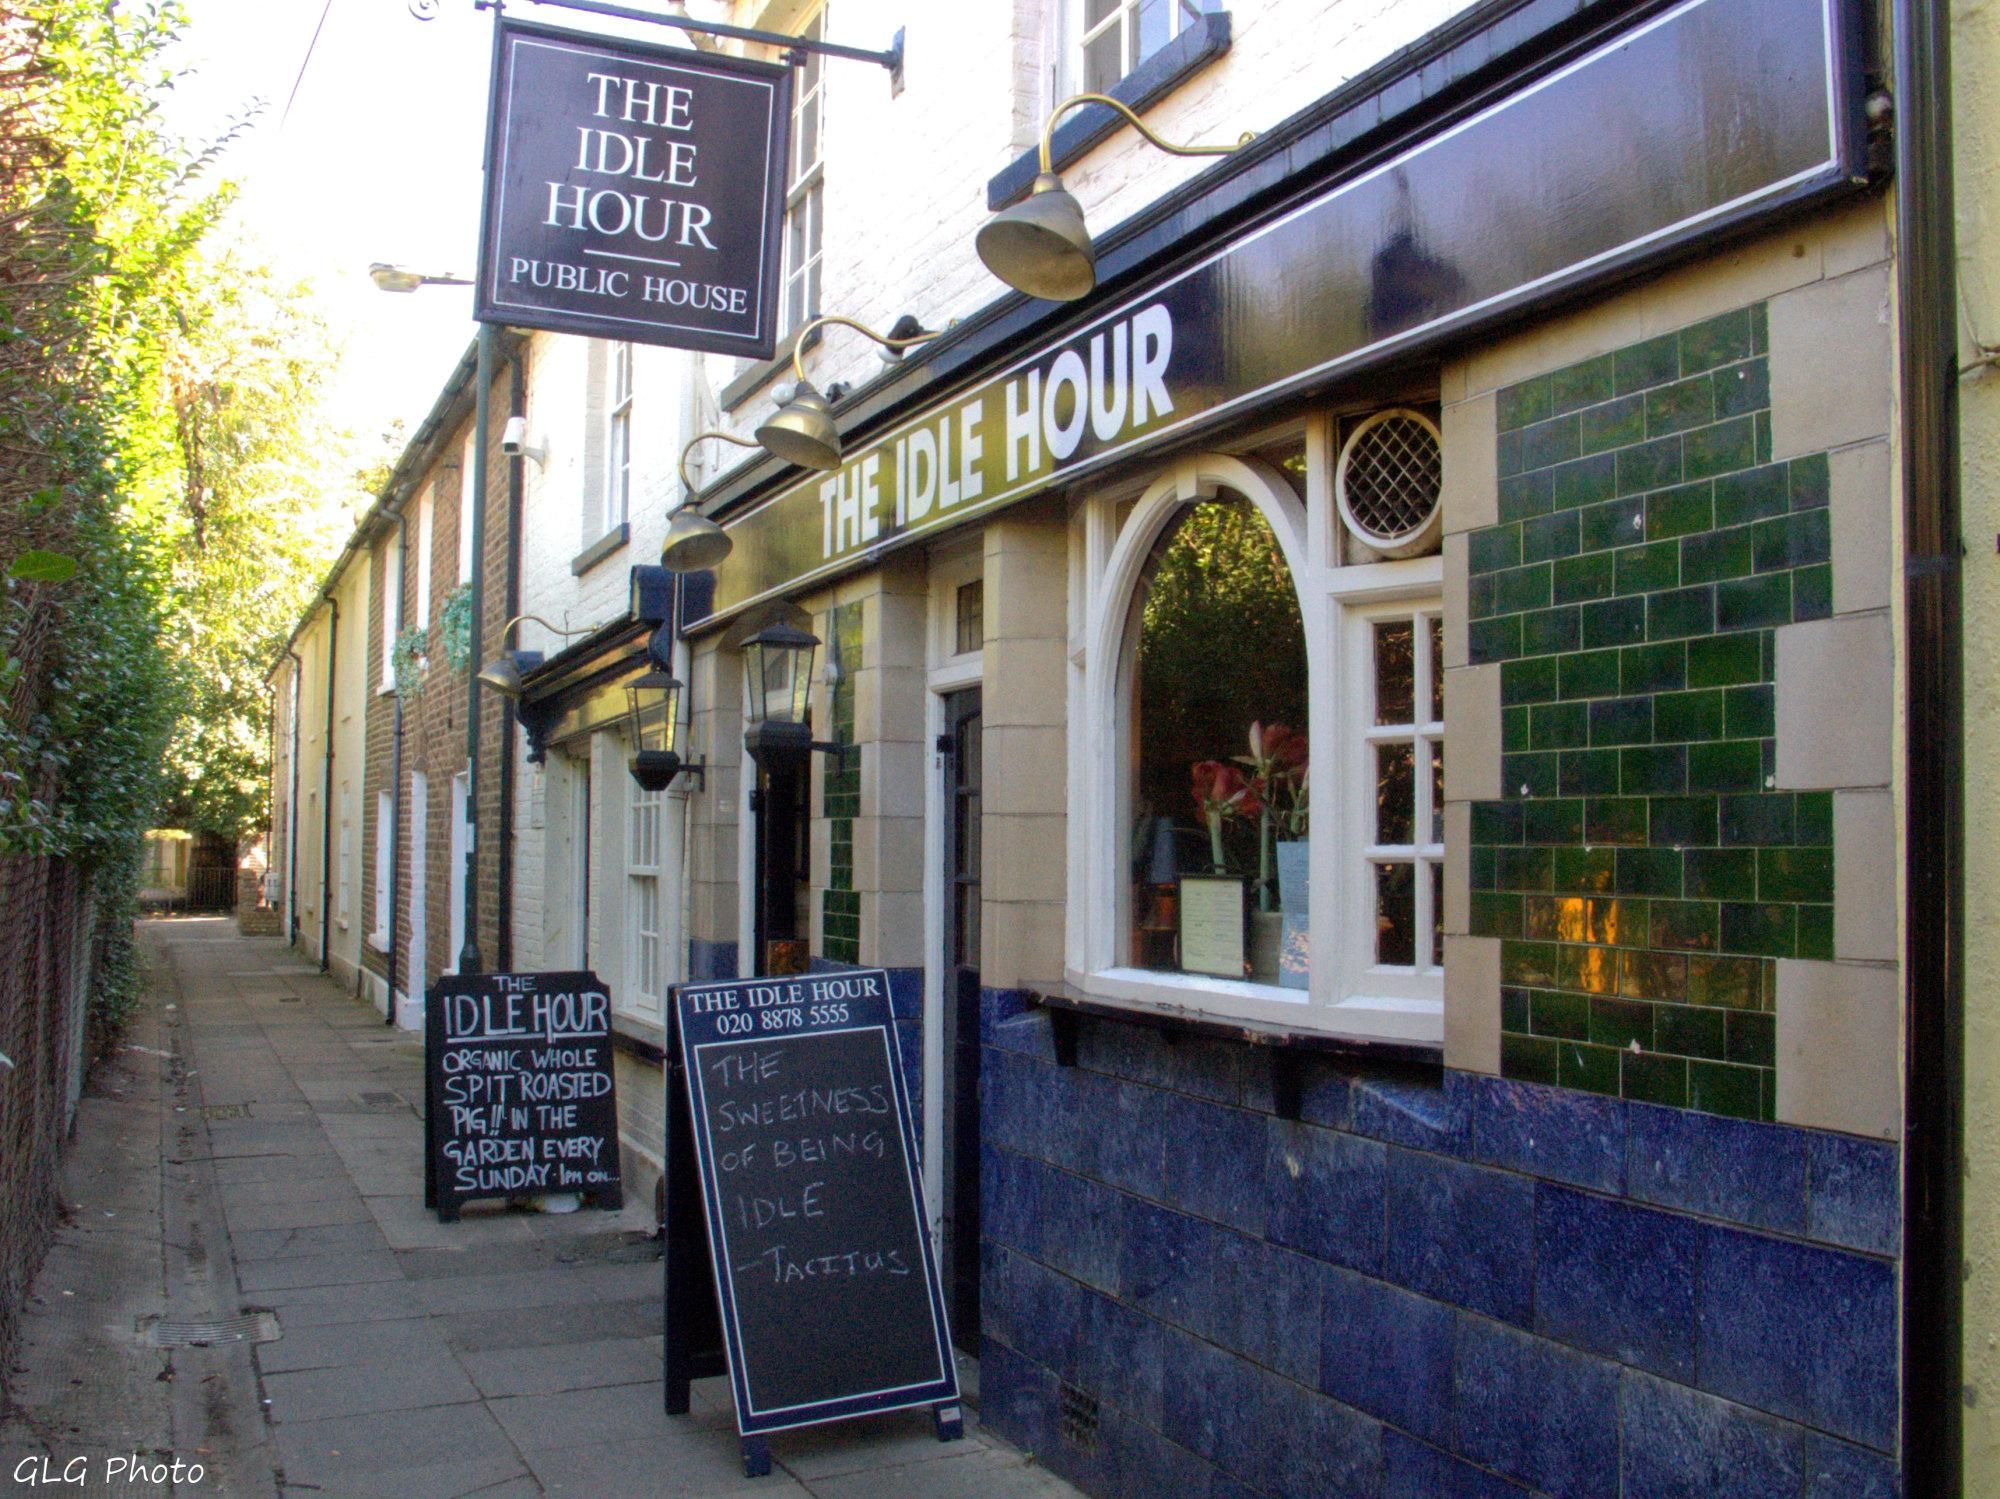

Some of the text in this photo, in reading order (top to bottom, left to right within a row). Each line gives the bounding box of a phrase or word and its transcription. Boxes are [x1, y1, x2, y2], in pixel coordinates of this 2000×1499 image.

[587, 72, 693, 131] THE
[573, 126, 697, 187] IDLE
[542, 181, 717, 250] HOUR
[509, 257, 747, 314] PUBLIC HOUSE
[820, 304, 1174, 559] THE IDLE HOUR
[492, 976, 536, 992] THE
[689, 977, 881, 1013] THE IDLE HOUR
[444, 992, 608, 1043] IDLE HOUR
[717, 1004, 849, 1035] 020 8878 5555
[442, 1049, 597, 1072] ORGANIC WHOLE
[712, 1051, 783, 1087] THE
[443, 1071, 611, 1104] SPIT ROASTED
[511, 1106, 528, 1130] IN
[536, 1105, 577, 1130] THE
[719, 1084, 889, 1132] SWEETNESS
[443, 1136, 604, 1166] GARDEN EVERY
[720, 1131, 884, 1171] OF BEING
[454, 1163, 550, 1191] SUNDAY
[738, 1181, 825, 1229] IDLE
